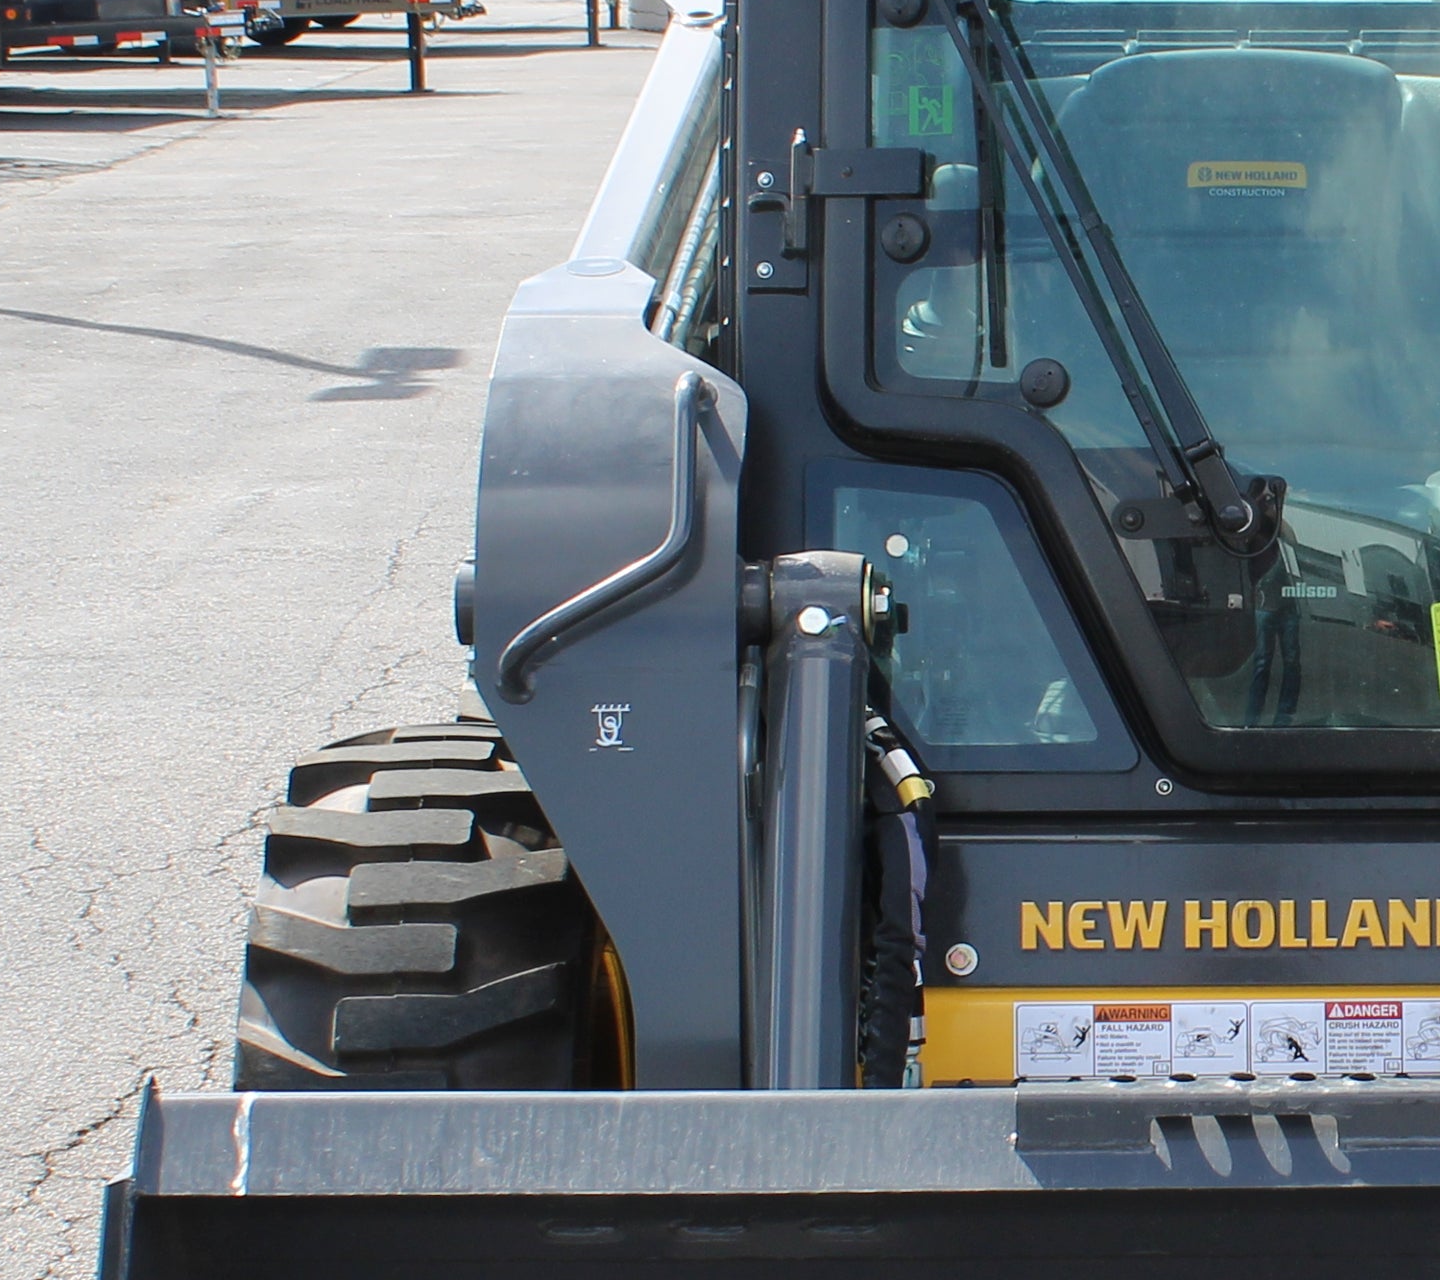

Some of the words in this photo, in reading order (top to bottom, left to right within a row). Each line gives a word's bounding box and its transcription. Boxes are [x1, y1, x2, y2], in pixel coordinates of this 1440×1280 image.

[1215, 170, 1242, 180] NEW
[1244, 170, 1298, 181] HOLLAND
[1208, 187, 1285, 197] CONSTRUCTION
[1281, 582, 1337, 598] milsco
[1020, 899, 1167, 951] NEW
[1109, 1007, 1168, 1019] WARNING
[1344, 1004, 1398, 1017] DANGER
[1101, 1024, 1123, 1032] FALL
[1126, 1024, 1164, 1032] HAZARD
[1328, 1021, 1360, 1029] CRUSH
[1362, 1021, 1399, 1029] HAZARD
